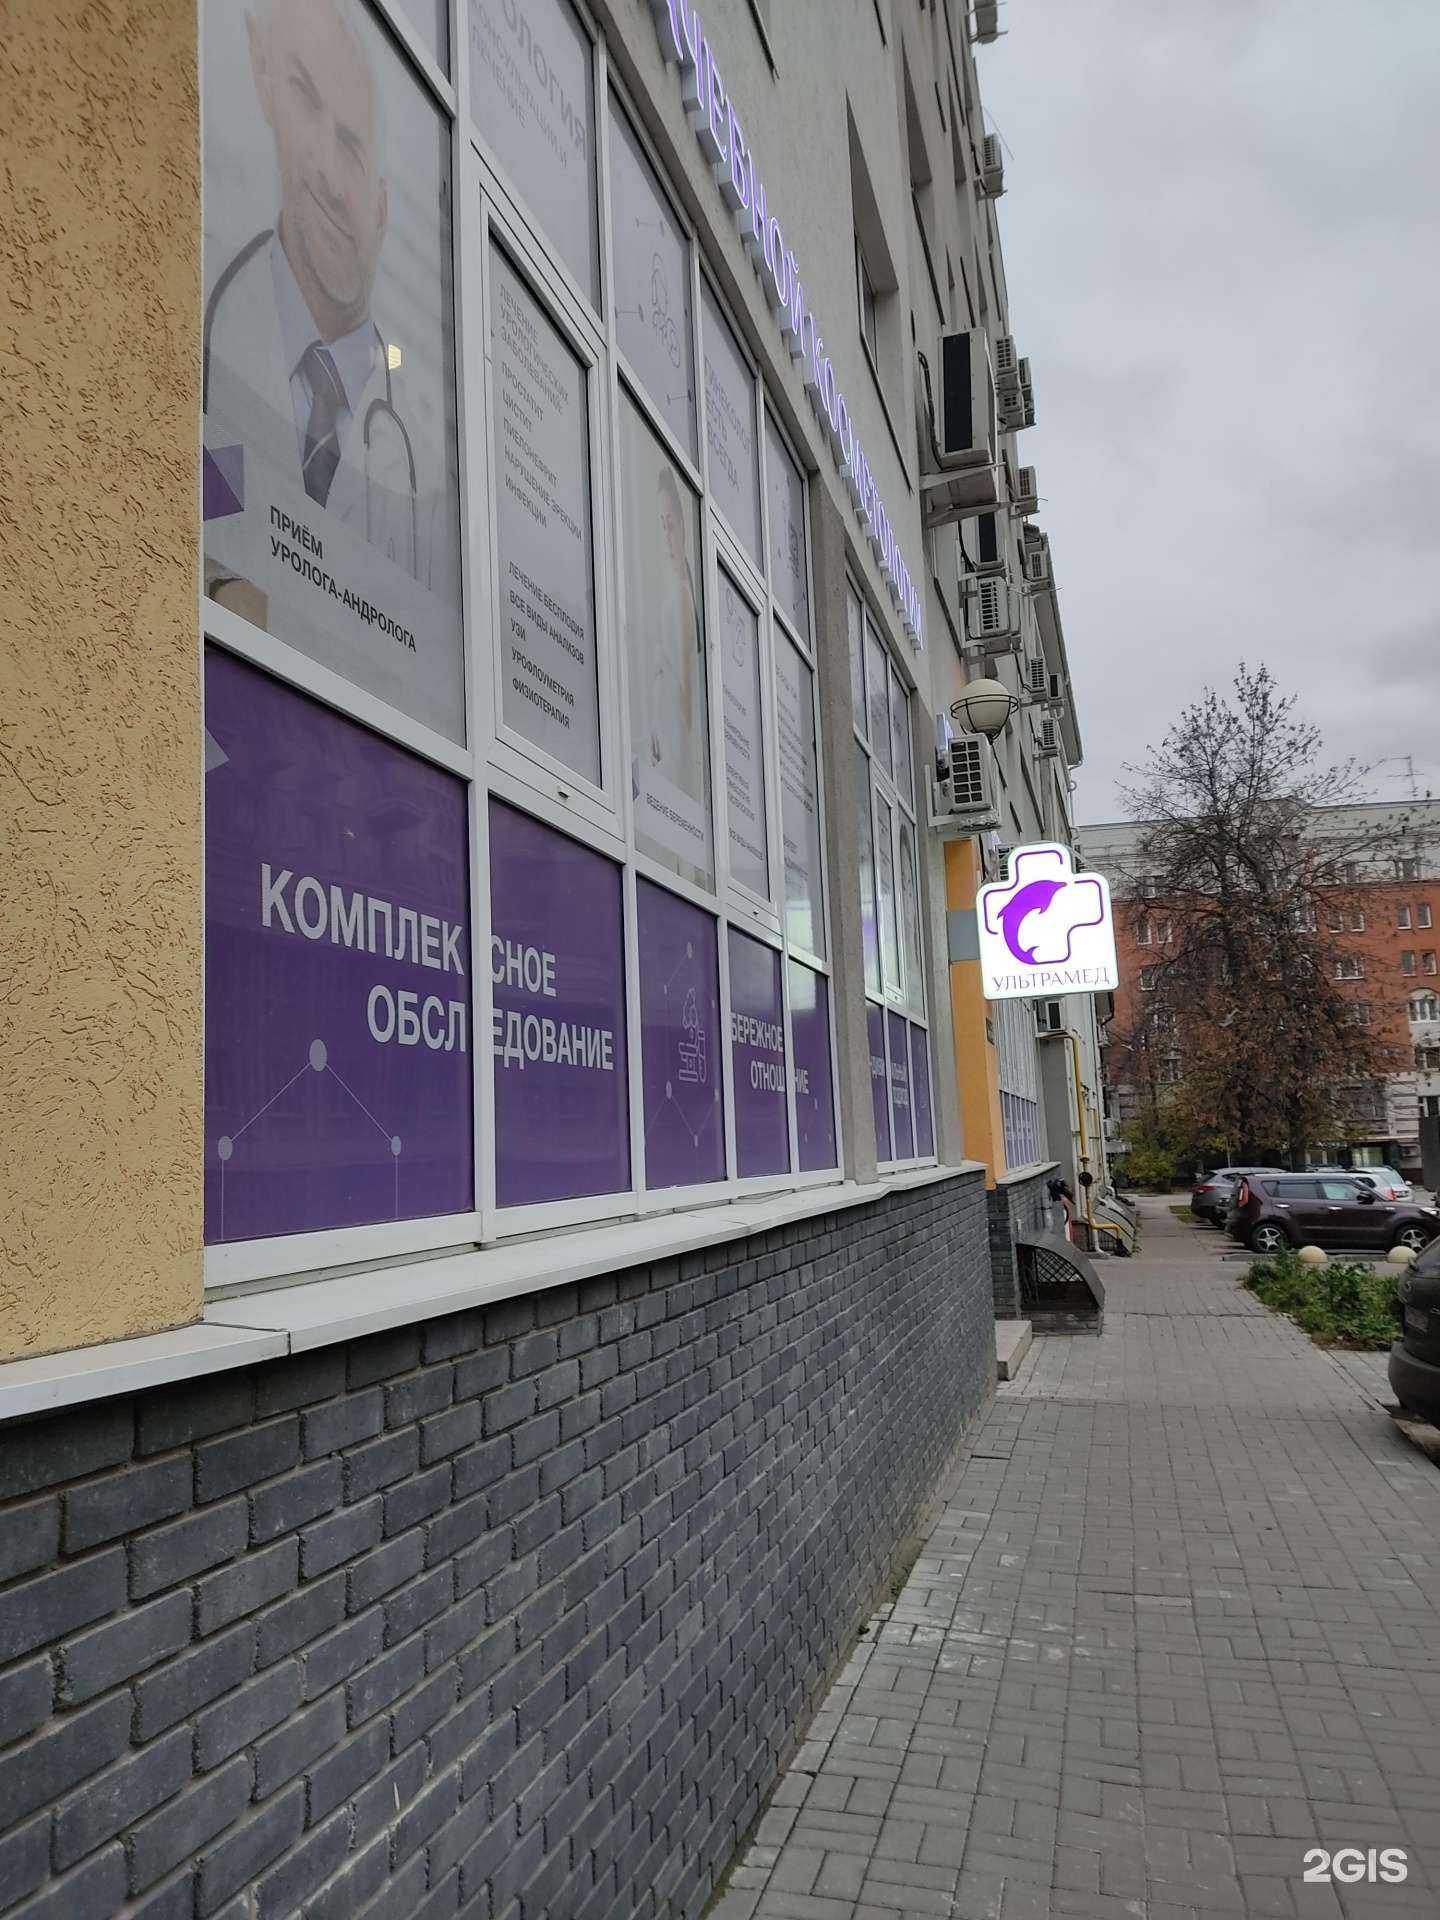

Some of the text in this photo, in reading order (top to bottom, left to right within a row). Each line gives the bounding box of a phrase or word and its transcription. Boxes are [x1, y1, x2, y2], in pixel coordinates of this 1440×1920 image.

[500, 284, 539, 345] ЛЕЧЕНИЕ
[502, 361, 543, 422] ПРОСТАТИТ
[502, 389, 533, 433] ЦИСТИТ
[503, 417, 557, 488] ПИЕЛОНЕФРИТ
[809, 311, 925, 650] КОСМЕТОЛОГИИ
[504, 446, 582, 541] НАРУШЕНИЕ ЭРЕКЦИИ
[505, 474, 547, 529] ИНФЕКЦИИ
[270, 505, 323, 560] ПРИЁМ
[270, 535, 417, 653] УРОЛОГА-АНДРОЛОГА
[509, 561, 585, 641] ЛЕЧЕНИЕ БЕСПЛОДИЯ
[510, 590, 585, 666] ВСЕ ВИДЫ АНАЛИЗОВ
[510, 617, 527, 642] УЗИ
[511, 647, 575, 708] УРОФЛОУМЕТРИЯ
[512, 677, 570, 730] ФИЗИОТЕРАПИЯ
[992, 967, 1110, 992] УЛЬТРАМЕД
[730, 1012, 784, 1053] БЕРЕЖНОЕ
[750, 1060, 809, 1095] ОТНОШНИЕ
